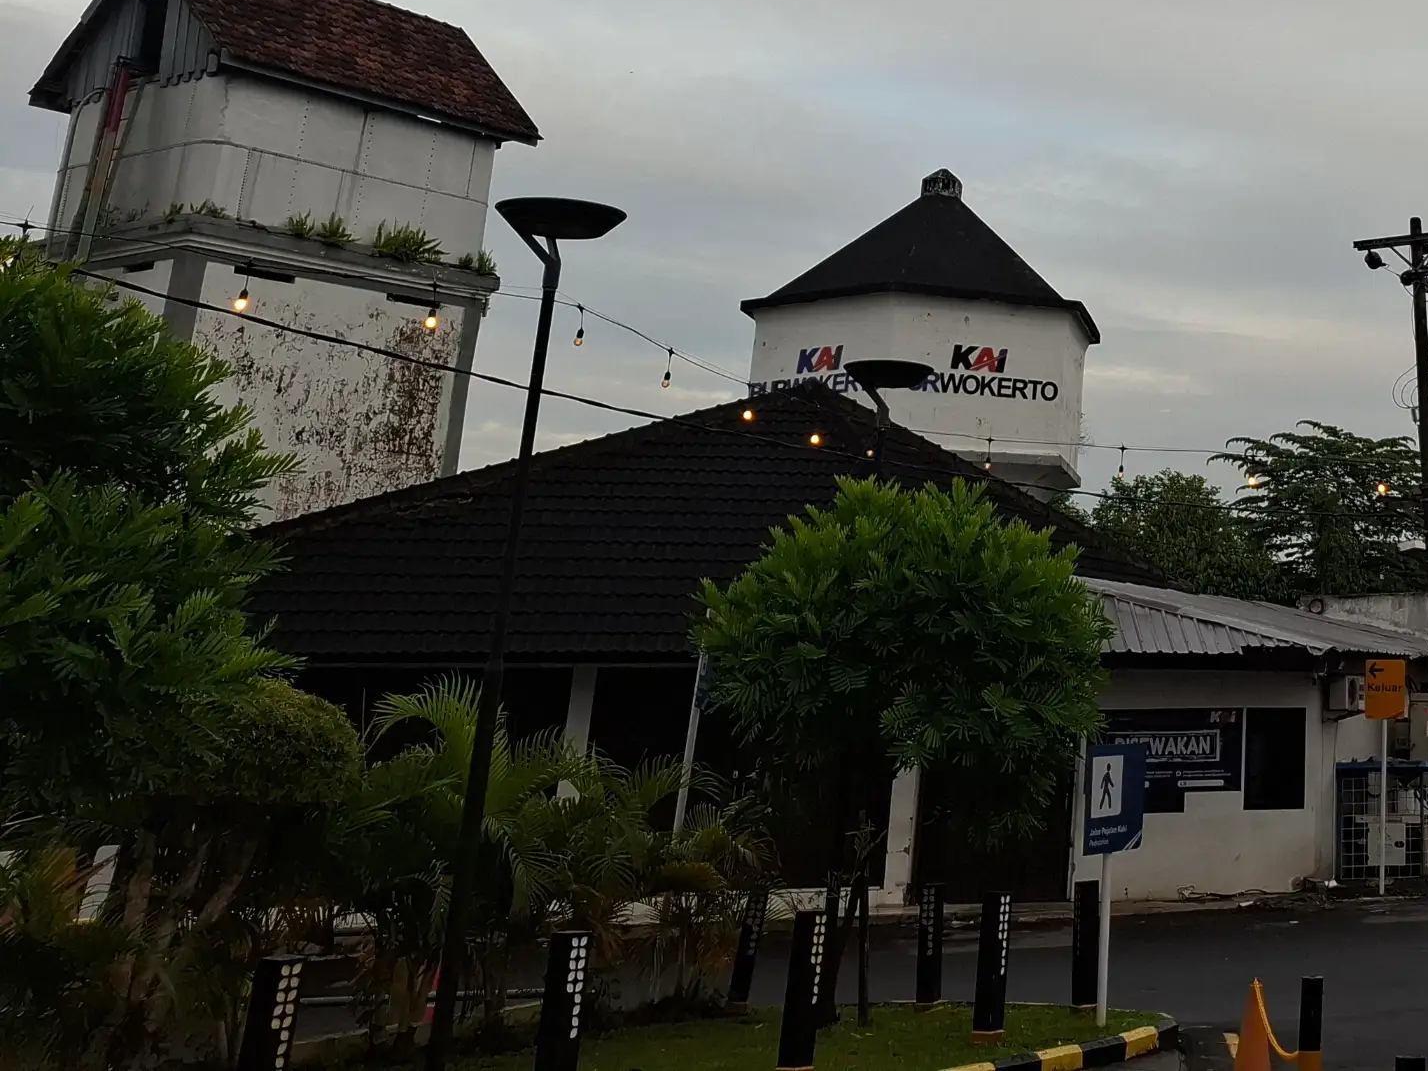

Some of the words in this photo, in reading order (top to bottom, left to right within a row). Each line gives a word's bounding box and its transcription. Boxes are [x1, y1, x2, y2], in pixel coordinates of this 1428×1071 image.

[797, 345, 844, 374] KAI
[951, 345, 1008, 373] KAI
[909, 372, 1058, 401] RWOKERTO
[1367, 681, 1403, 692] Keluar
[1209, 710, 1237, 723] KI
